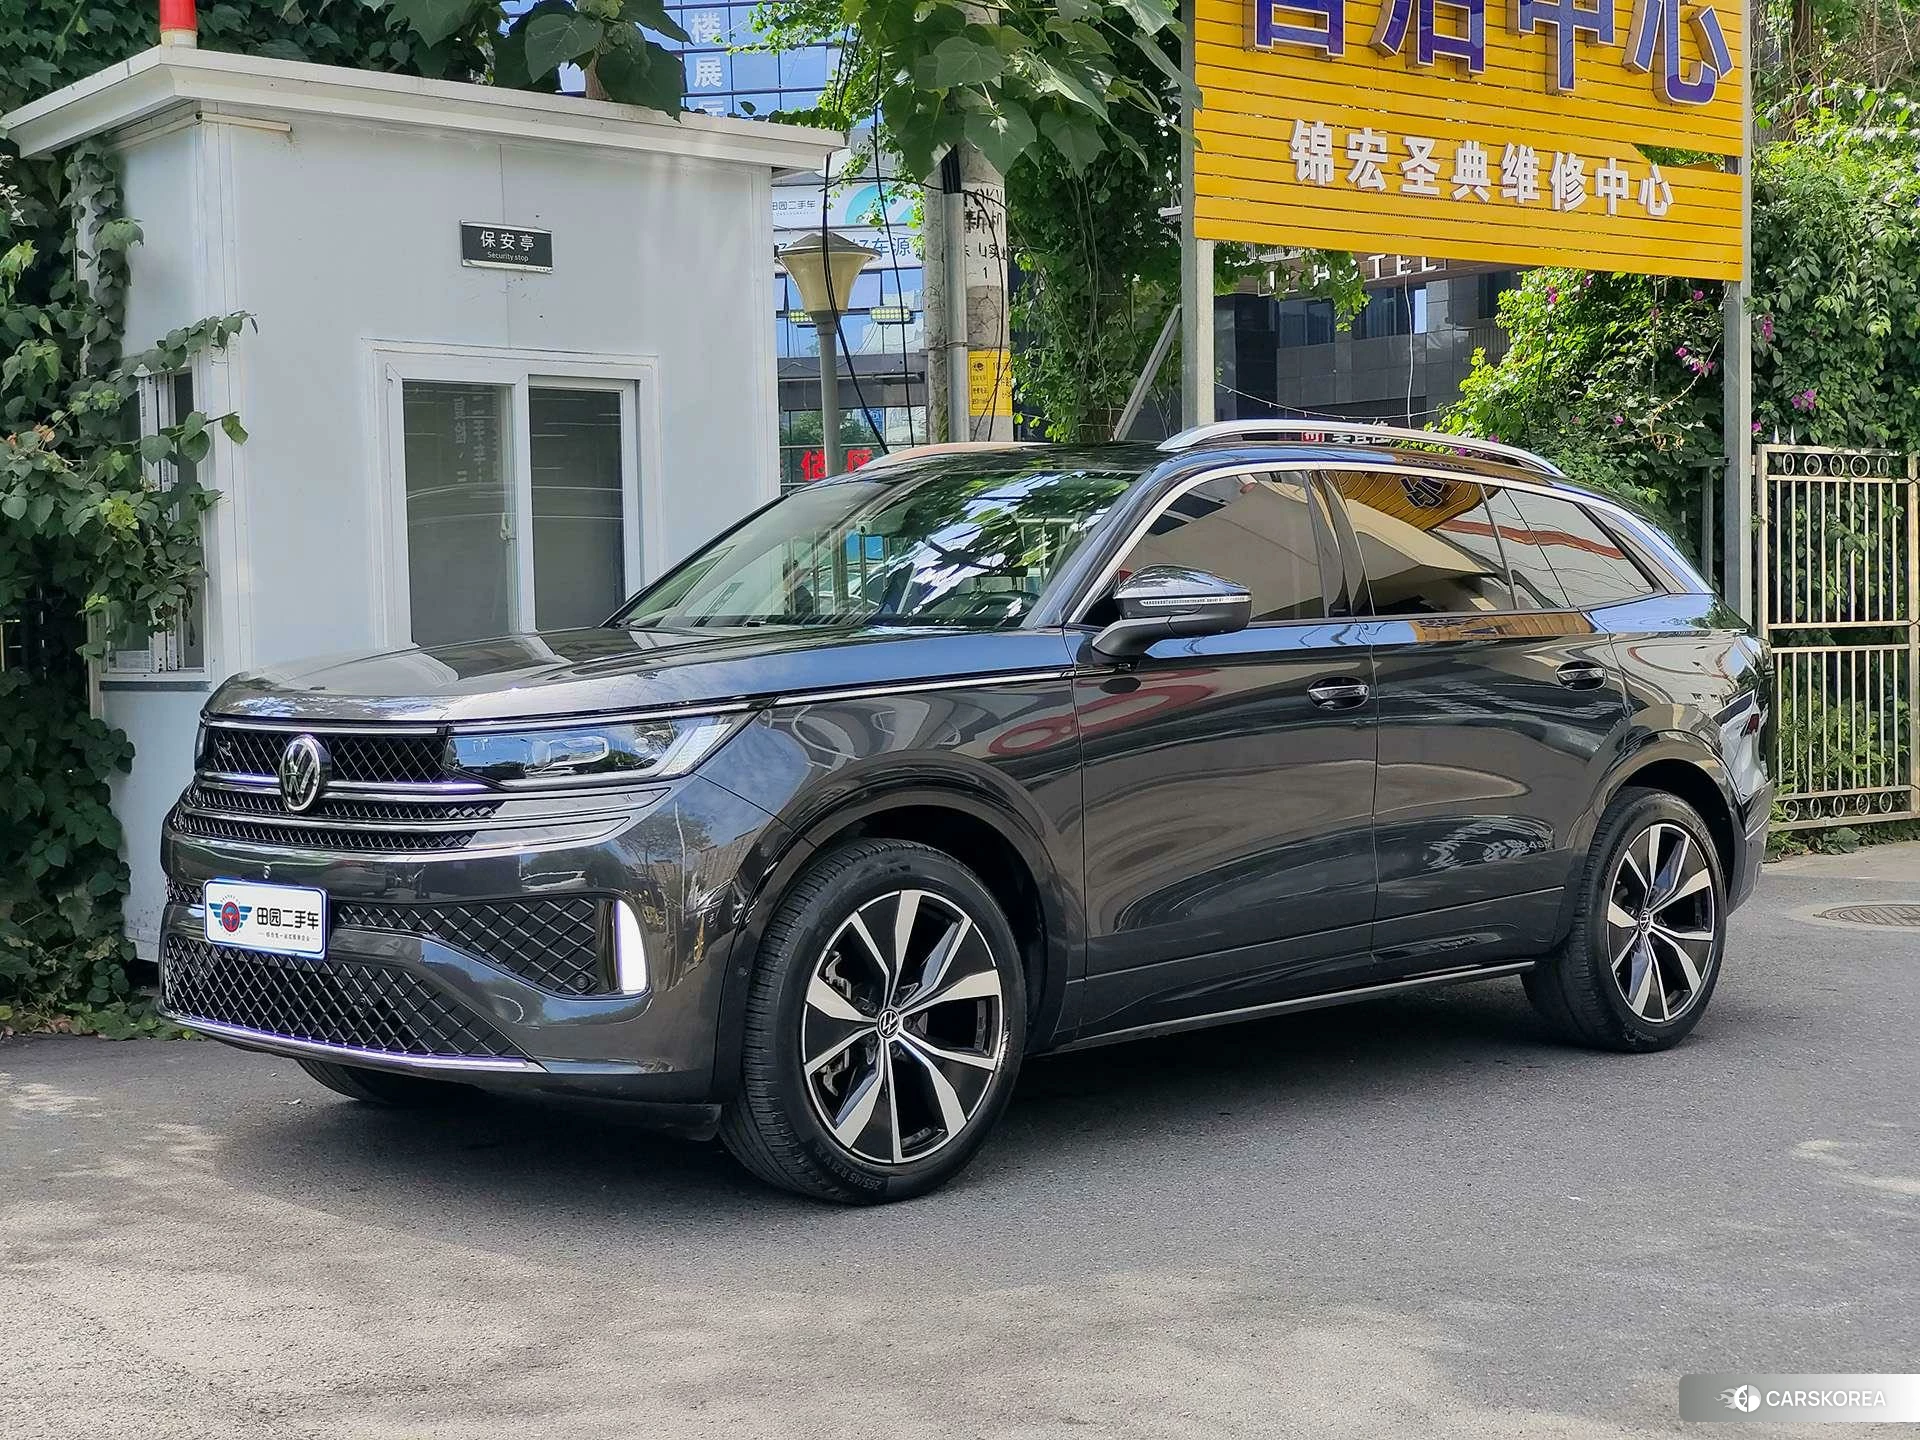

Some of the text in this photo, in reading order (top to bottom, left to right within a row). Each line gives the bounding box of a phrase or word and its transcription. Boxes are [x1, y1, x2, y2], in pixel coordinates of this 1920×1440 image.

[1290, 119, 1674, 217] 锦宏圣典维修中心
[480, 230, 534, 252] 保安亭
[487, 251, 529, 263] Security stop
[256, 907, 319, 930] 田园二手车
